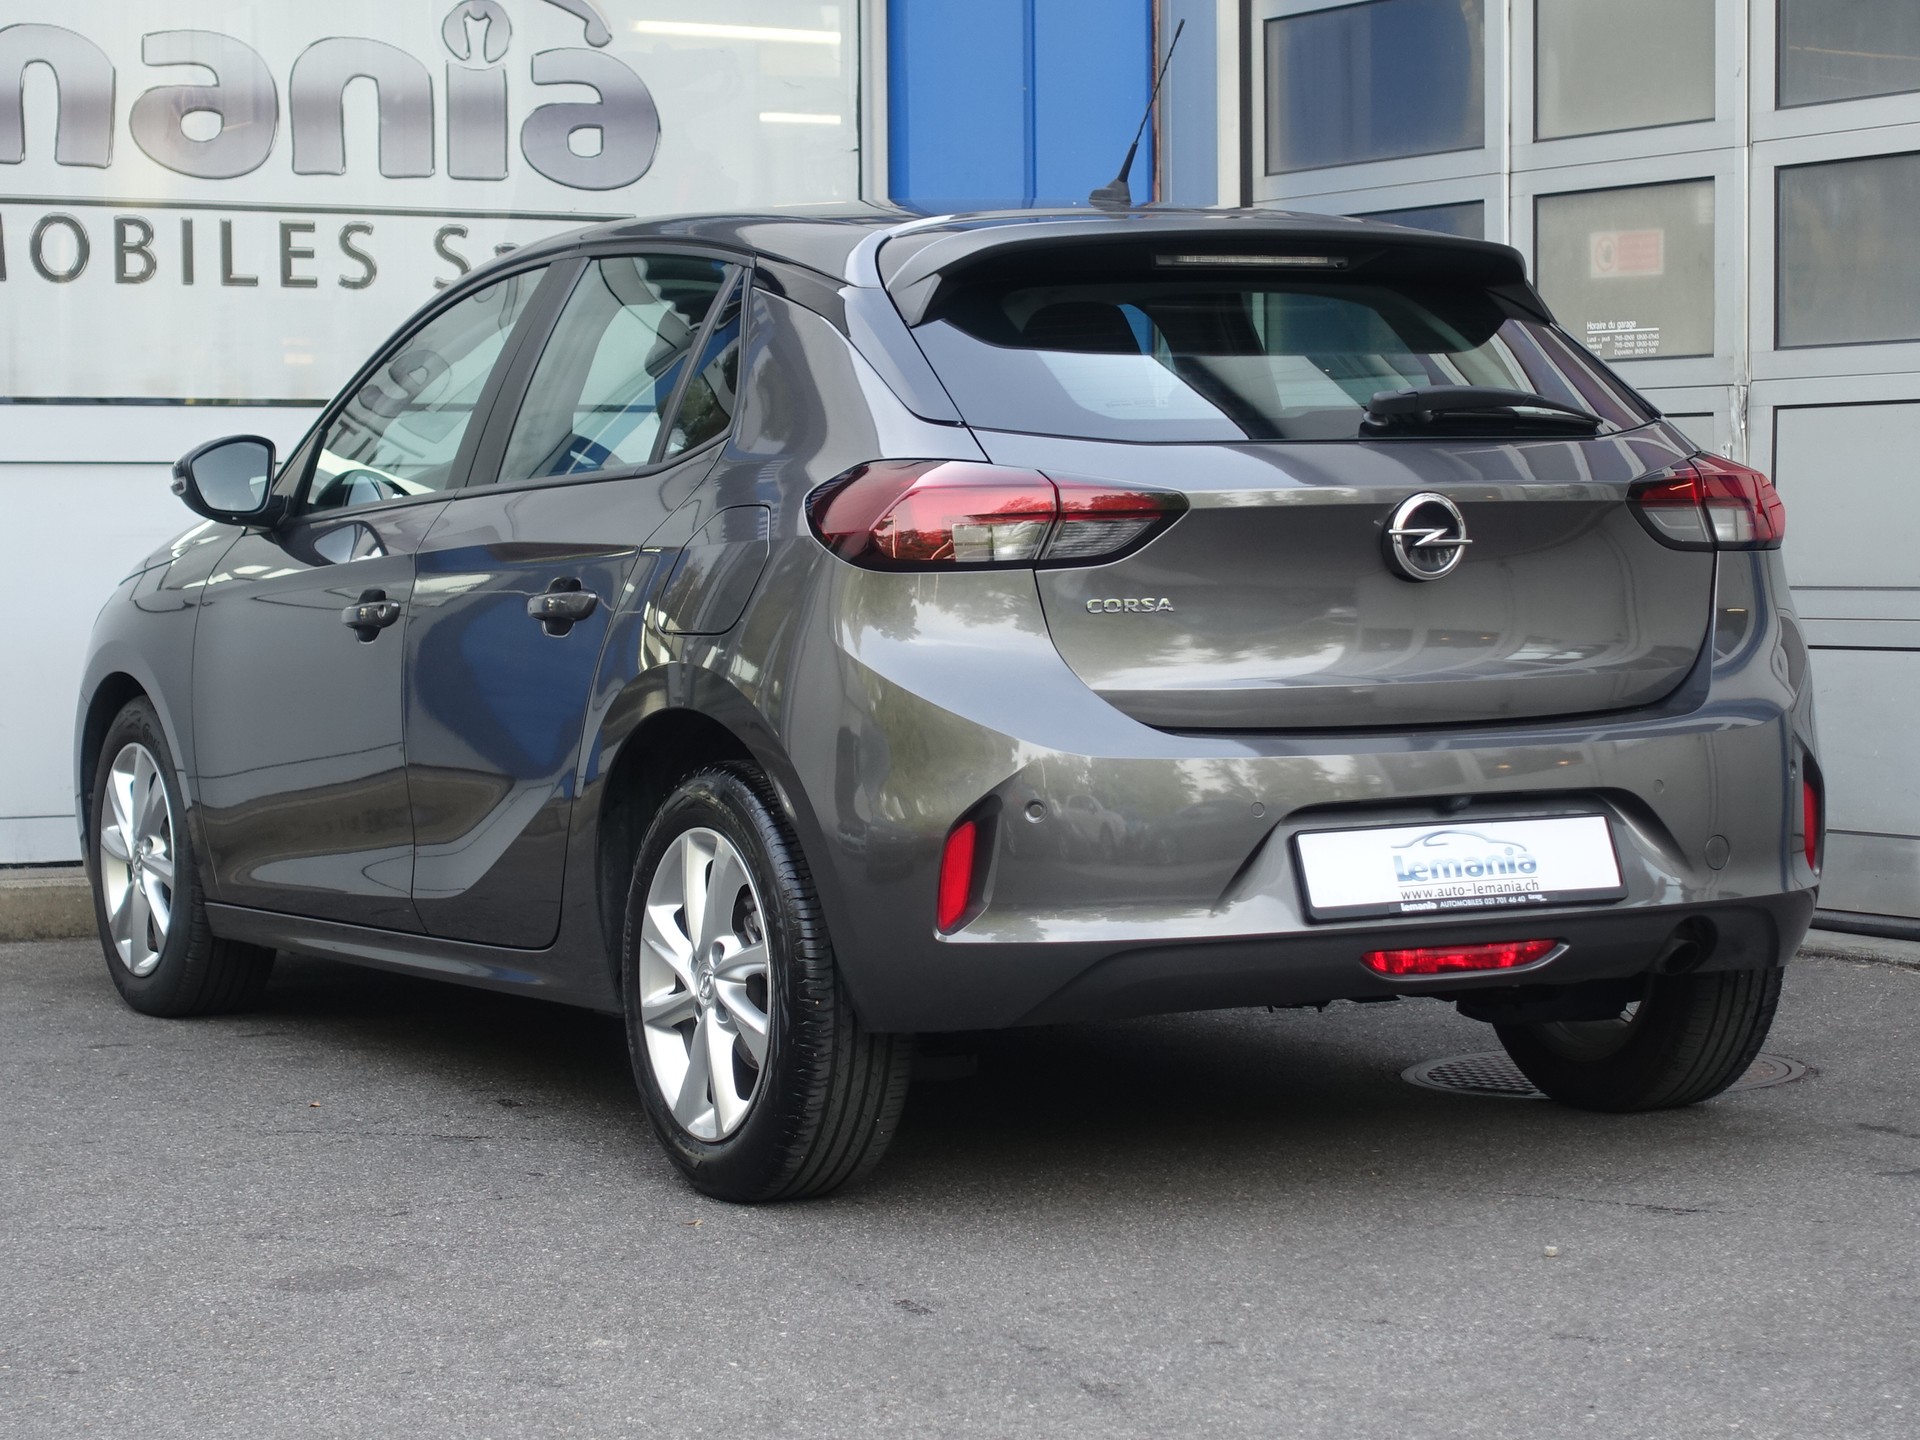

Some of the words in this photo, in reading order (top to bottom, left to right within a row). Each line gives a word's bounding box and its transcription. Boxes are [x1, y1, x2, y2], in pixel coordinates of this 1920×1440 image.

[0, 211, 377, 289] OBILES
[433, 224, 520, 289] S
[1587, 321, 1606, 330] Horaire
[1608, 321, 1615, 329] du
[1617, 320, 1636, 330] garage
[1086, 598, 1174, 613] CORSA
[1401, 879, 1539, 899] www.auto-lemania.ch
[1440, 898, 1483, 908] AUTOMOBILES
